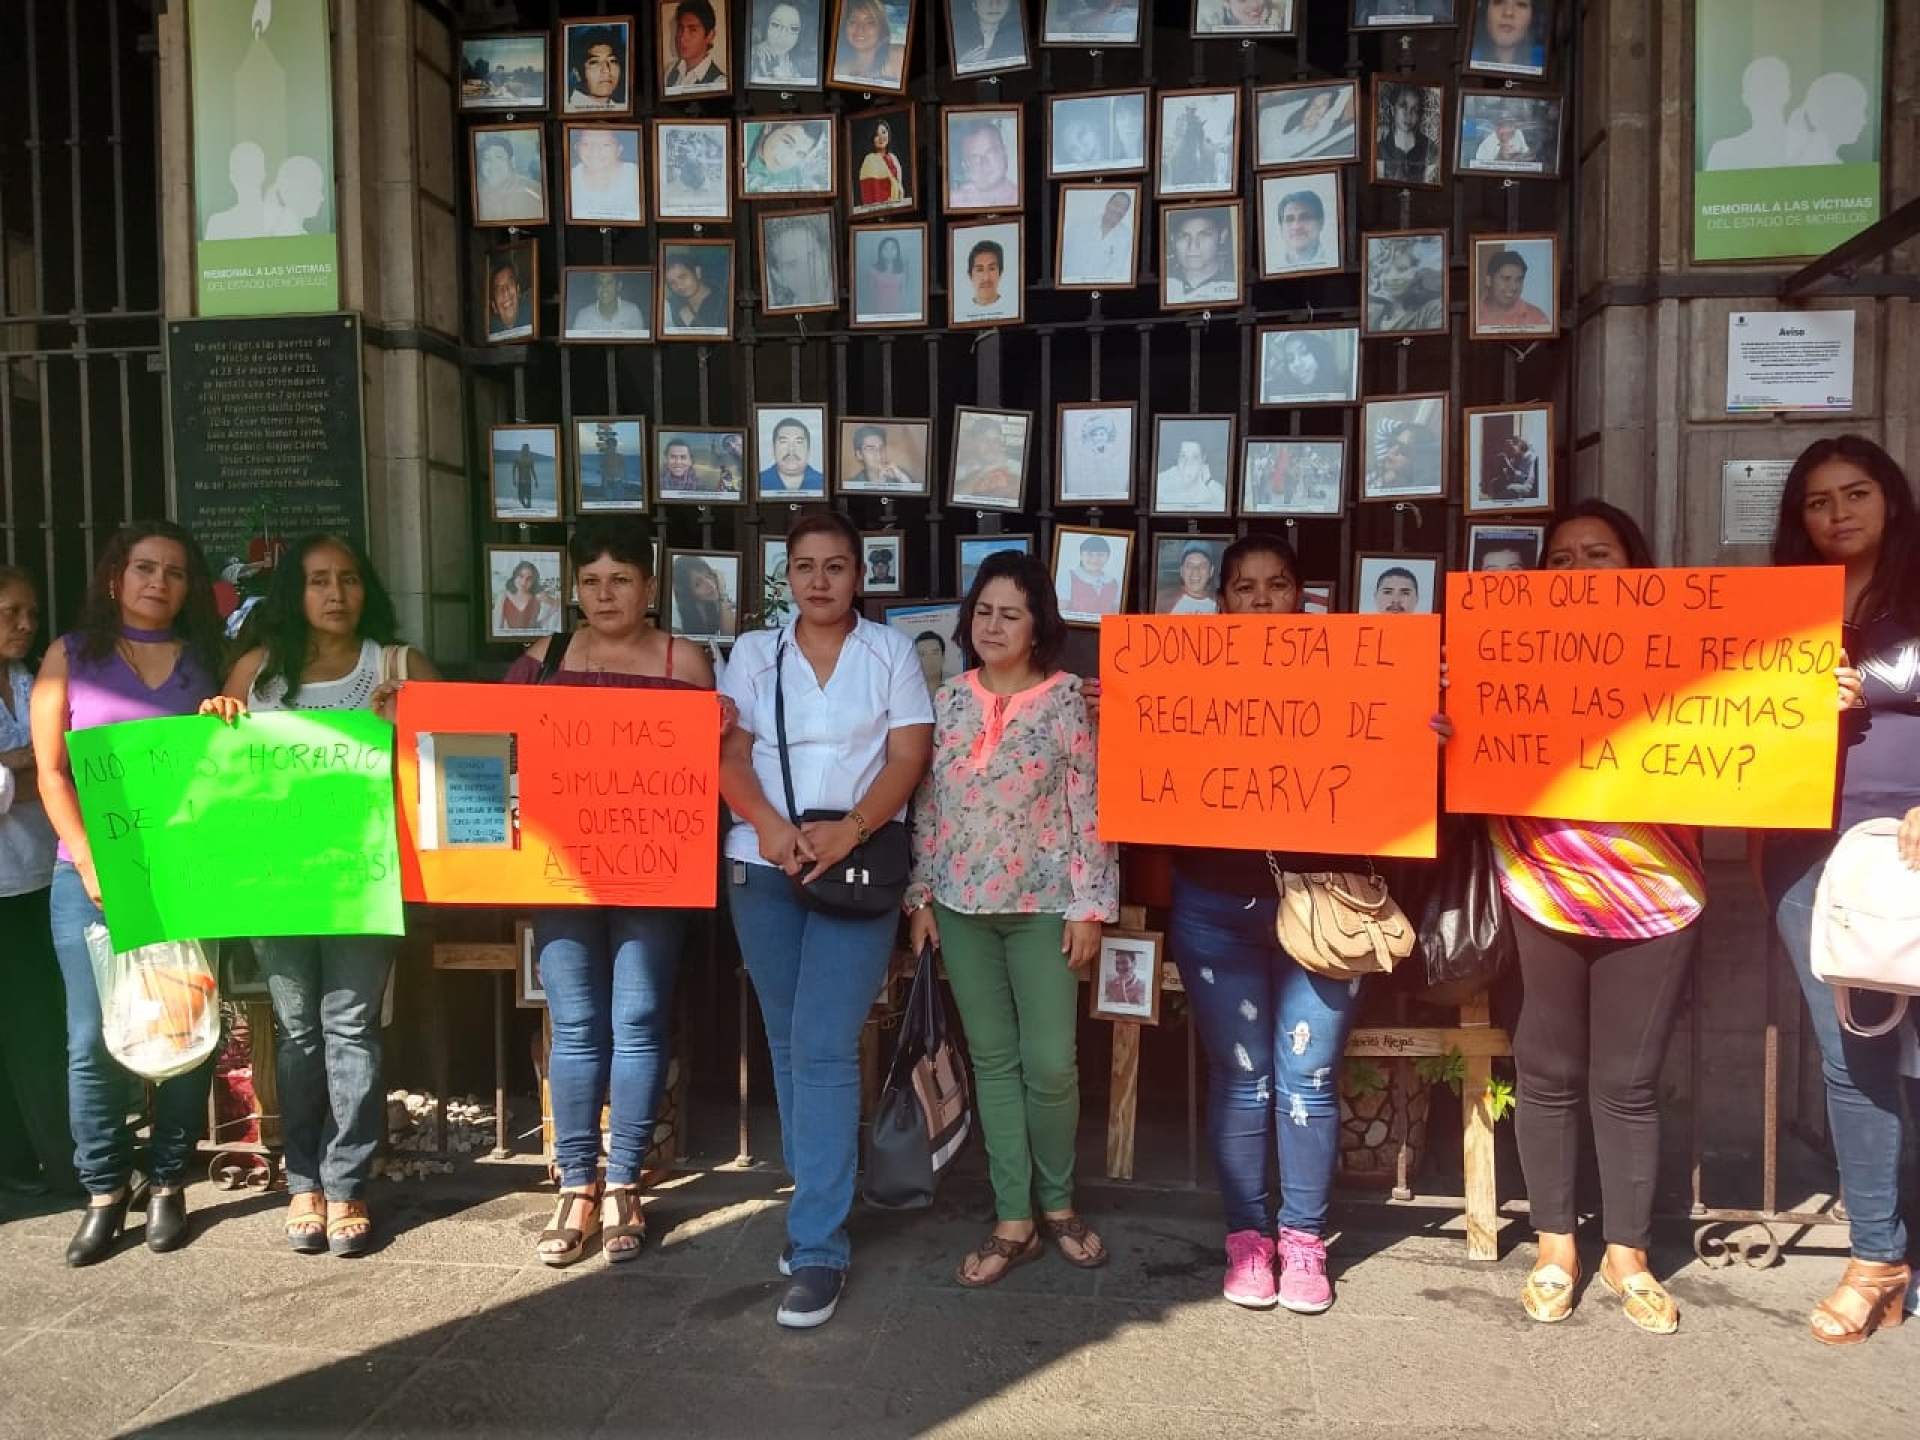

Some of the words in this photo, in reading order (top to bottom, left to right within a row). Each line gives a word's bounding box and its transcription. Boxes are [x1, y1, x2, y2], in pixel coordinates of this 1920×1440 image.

[1702, 203, 1771, 216] MEMORIAL
[1772, 201, 1782, 212] A
[1784, 200, 1809, 212] LAS
[1812, 196, 1873, 210] VÍCTIMAS
[1706, 218, 1732, 230] DEL
[1734, 215, 1783, 229] ESTADO
[1785, 215, 1801, 226] DE
[1805, 211, 1869, 225] MORELOS
[203, 266, 254, 279] MEMORIAL
[255, 266, 263, 277] A
[264, 265, 285, 277] LAS
[207, 280, 225, 291] DEL
[227, 279, 265, 290] ESTADO
[266, 278, 283, 289] DE
[284, 276, 328, 287] MORELOS
[1778, 326, 1806, 337] Aviso
[1460, 575, 1532, 611] ¿POR
[1549, 574, 1600, 607] QUE
[1616, 573, 1665, 608] NO
[1683, 574, 1728, 610] SE
[1114, 618, 1242, 675] ¿DONDE
[1263, 626, 1330, 668] ESTA
[1354, 626, 1395, 667] EL
[1478, 629, 1625, 665] GESTIONO
[1644, 634, 1682, 669] EL
[1700, 636, 1834, 675] RECURSO
[1135, 695, 1321, 738] REGLAMENTO
[1347, 701, 1387, 741] DE
[1477, 681, 1550, 715] PARA
[1571, 682, 1625, 719] LAS
[1643, 691, 1806, 730] VICTIMAS
[612, 720, 676, 748] MAS
[84, 752, 126, 787] NO
[247, 743, 384, 771] HORARIO
[1474, 733, 1551, 766] ANTE
[1578, 738, 1619, 770] LA
[1641, 743, 1756, 791] CEAV?
[551, 765, 708, 796] SIMULACIÓN
[1139, 767, 1179, 804] LA
[1200, 764, 1352, 824] CEARV?
[105, 807, 154, 841] DE
[578, 807, 705, 836] QUEREMOS
